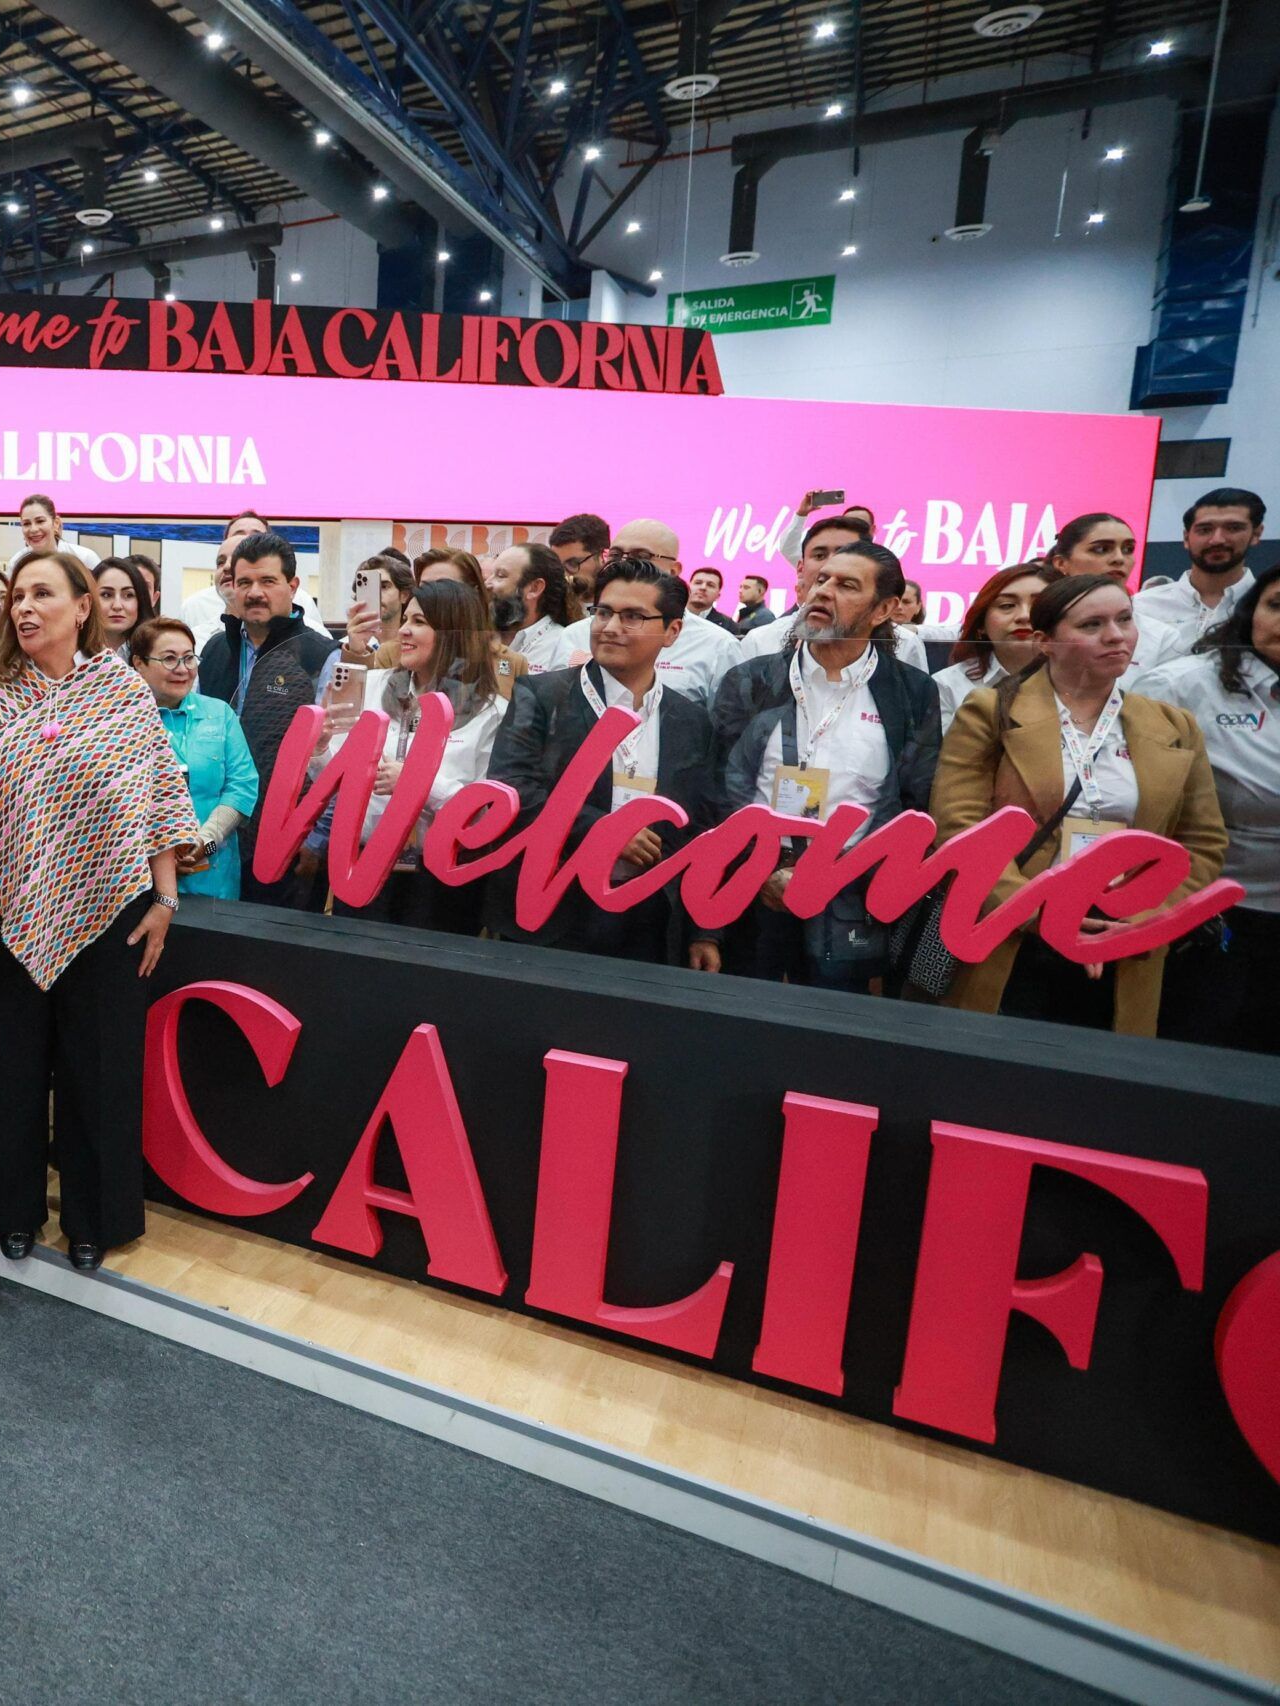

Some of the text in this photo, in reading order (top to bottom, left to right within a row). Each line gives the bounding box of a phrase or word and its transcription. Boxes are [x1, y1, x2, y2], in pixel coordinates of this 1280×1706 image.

[693, 297, 735, 311] SALIDA
[709, 306, 789, 325] EMERGENCIA
[86, 298, 141, 370] to
[148, 299, 318, 375] BAJA
[322, 308, 725, 396] CALIFORNIA
[882, 499, 1059, 572] to BAJA
[253, 691, 1246, 967] Welcome
[142, 979, 1280, 1486] CALIF
